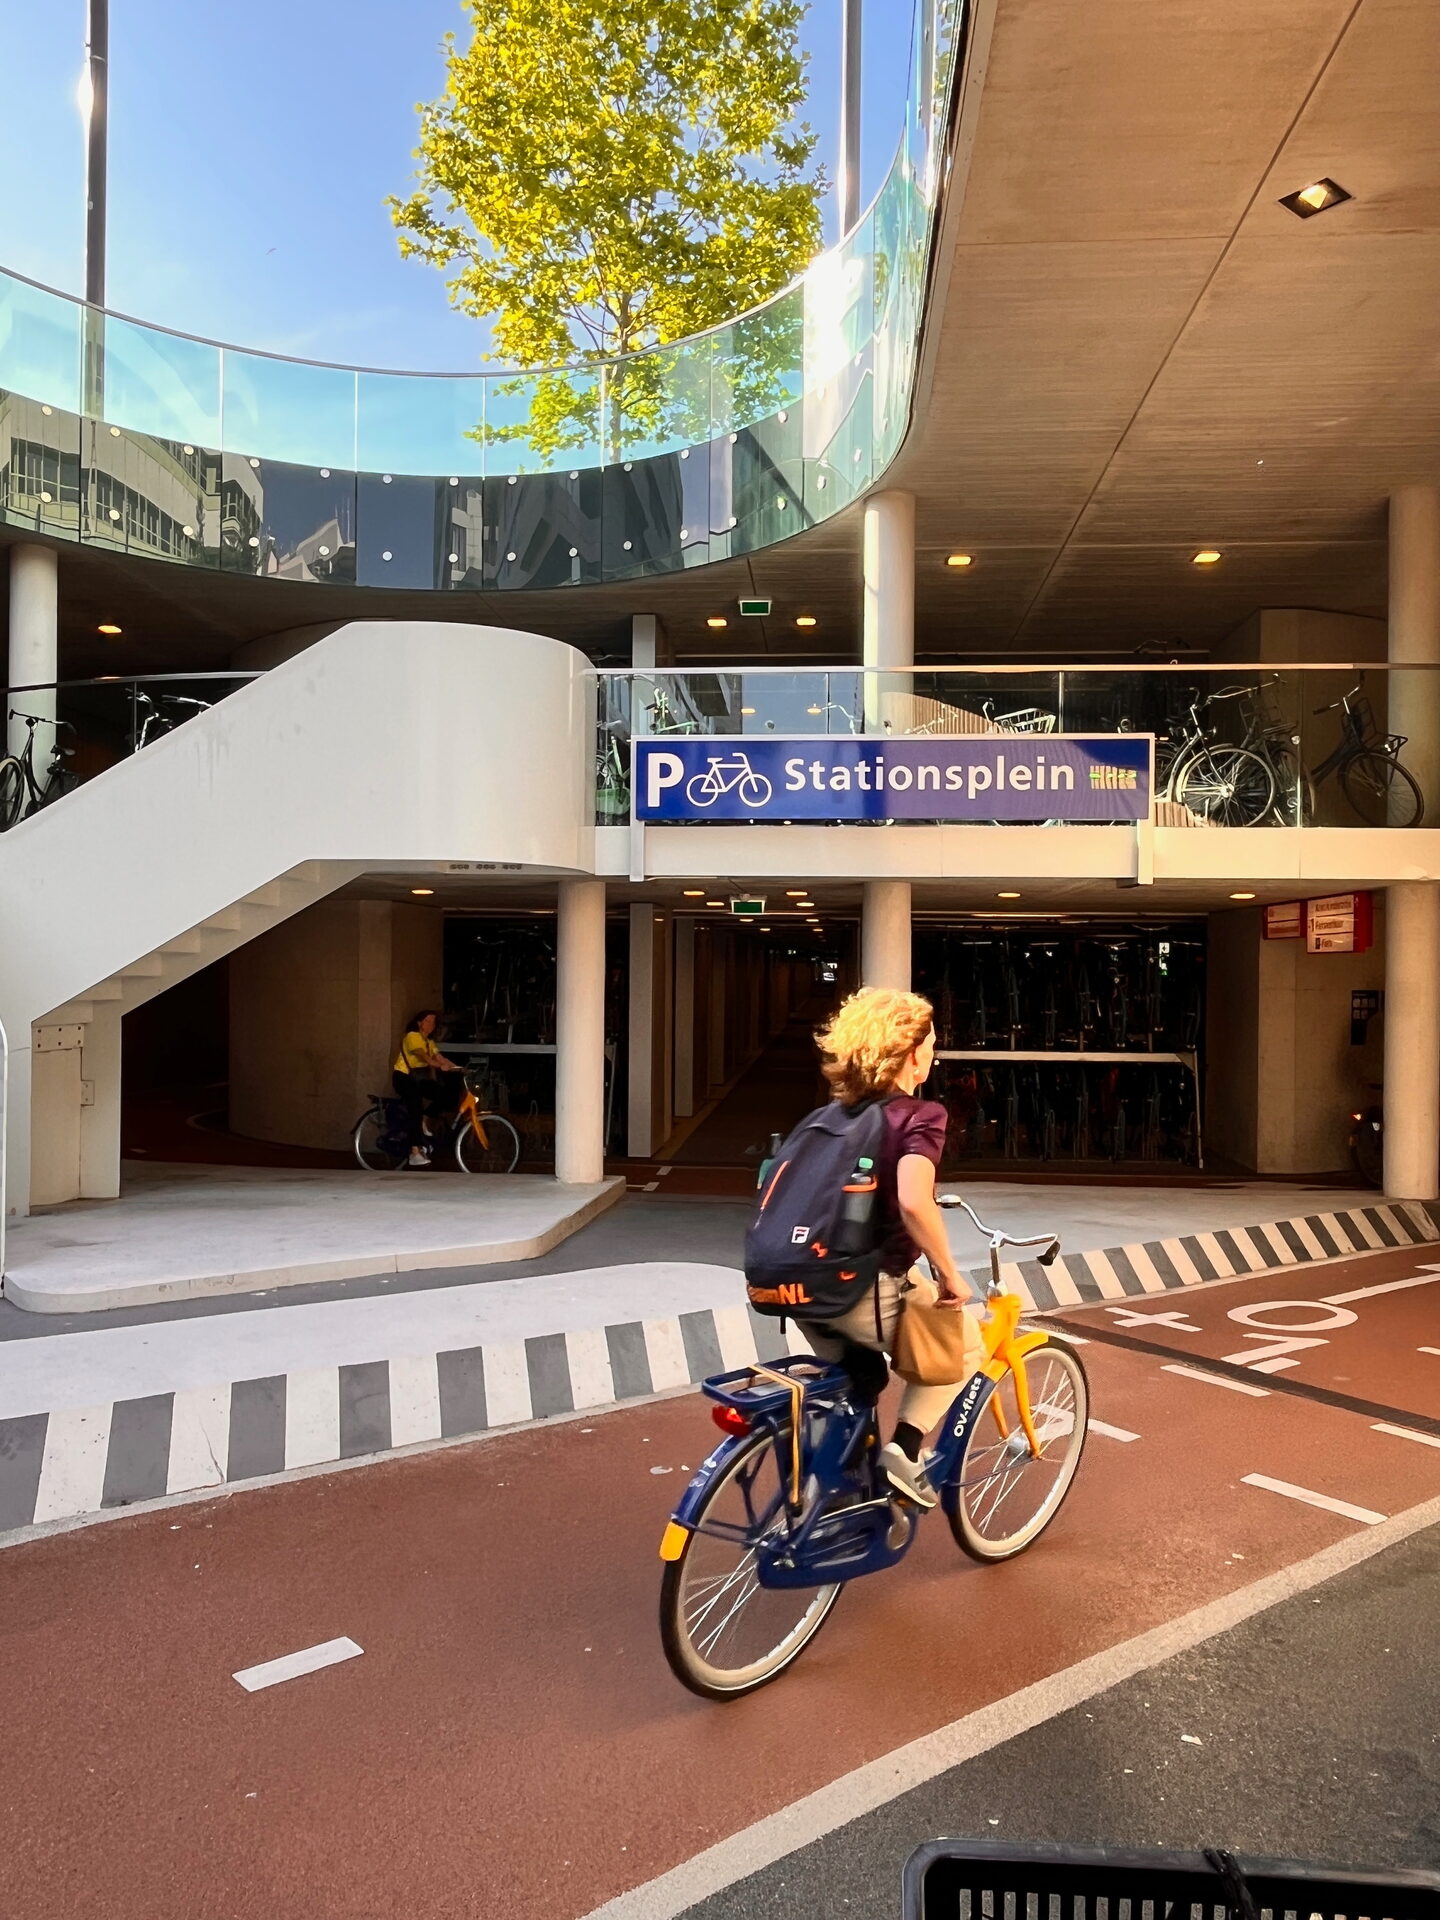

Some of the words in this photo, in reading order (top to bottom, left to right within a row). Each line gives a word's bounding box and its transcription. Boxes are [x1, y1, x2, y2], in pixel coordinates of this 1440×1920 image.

[647, 752, 684, 807] P
[784, 755, 1075, 799] Stationsplein
[953, 1376, 983, 1438] OV-fiets
